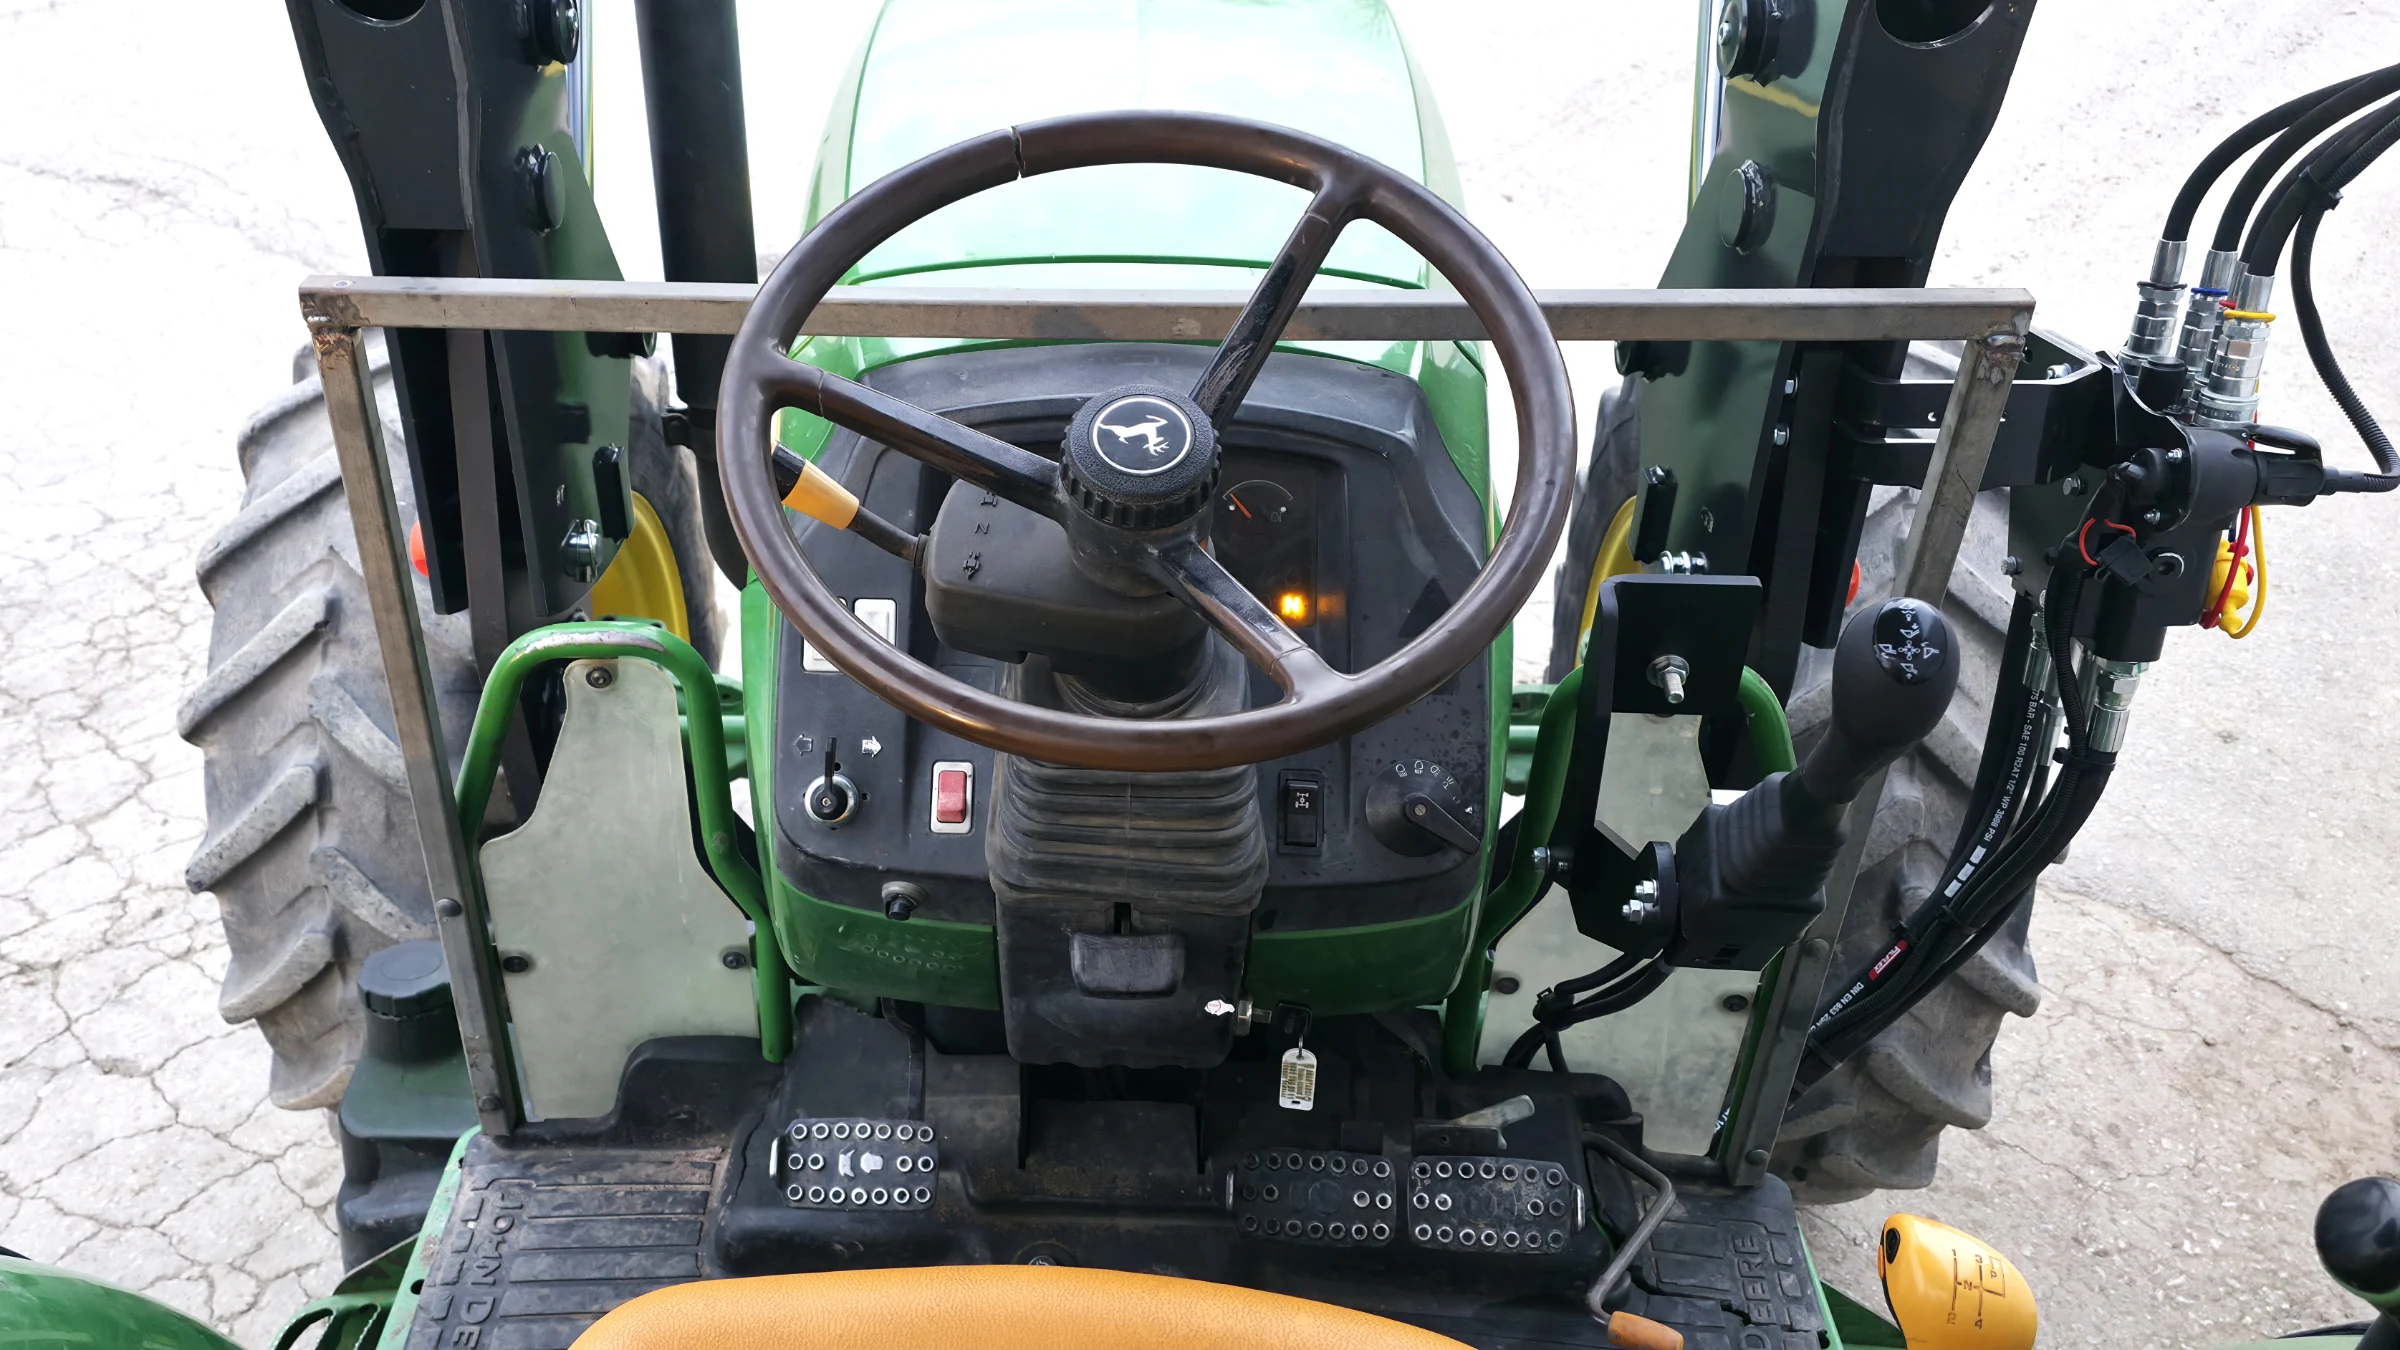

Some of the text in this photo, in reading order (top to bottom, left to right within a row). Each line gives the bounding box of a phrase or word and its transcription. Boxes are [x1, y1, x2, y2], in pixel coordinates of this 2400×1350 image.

[975, 522, 990, 534] N
[1285, 597, 1300, 613] N
[2026, 702, 2037, 718] BAR
[2022, 725, 2032, 740] SAE
[2017, 743, 2026, 756] 100
[2010, 757, 2023, 778] R2AT
[2000, 796, 2011, 809] WP
[1983, 828, 1995, 842] PSI
[1849, 981, 1864, 995] DIN
[1840, 992, 1851, 1004] EN
[1974, 1254, 1982, 1263] 3
[1963, 1280, 1972, 1290] N
[1974, 1318, 1982, 1329] 4
